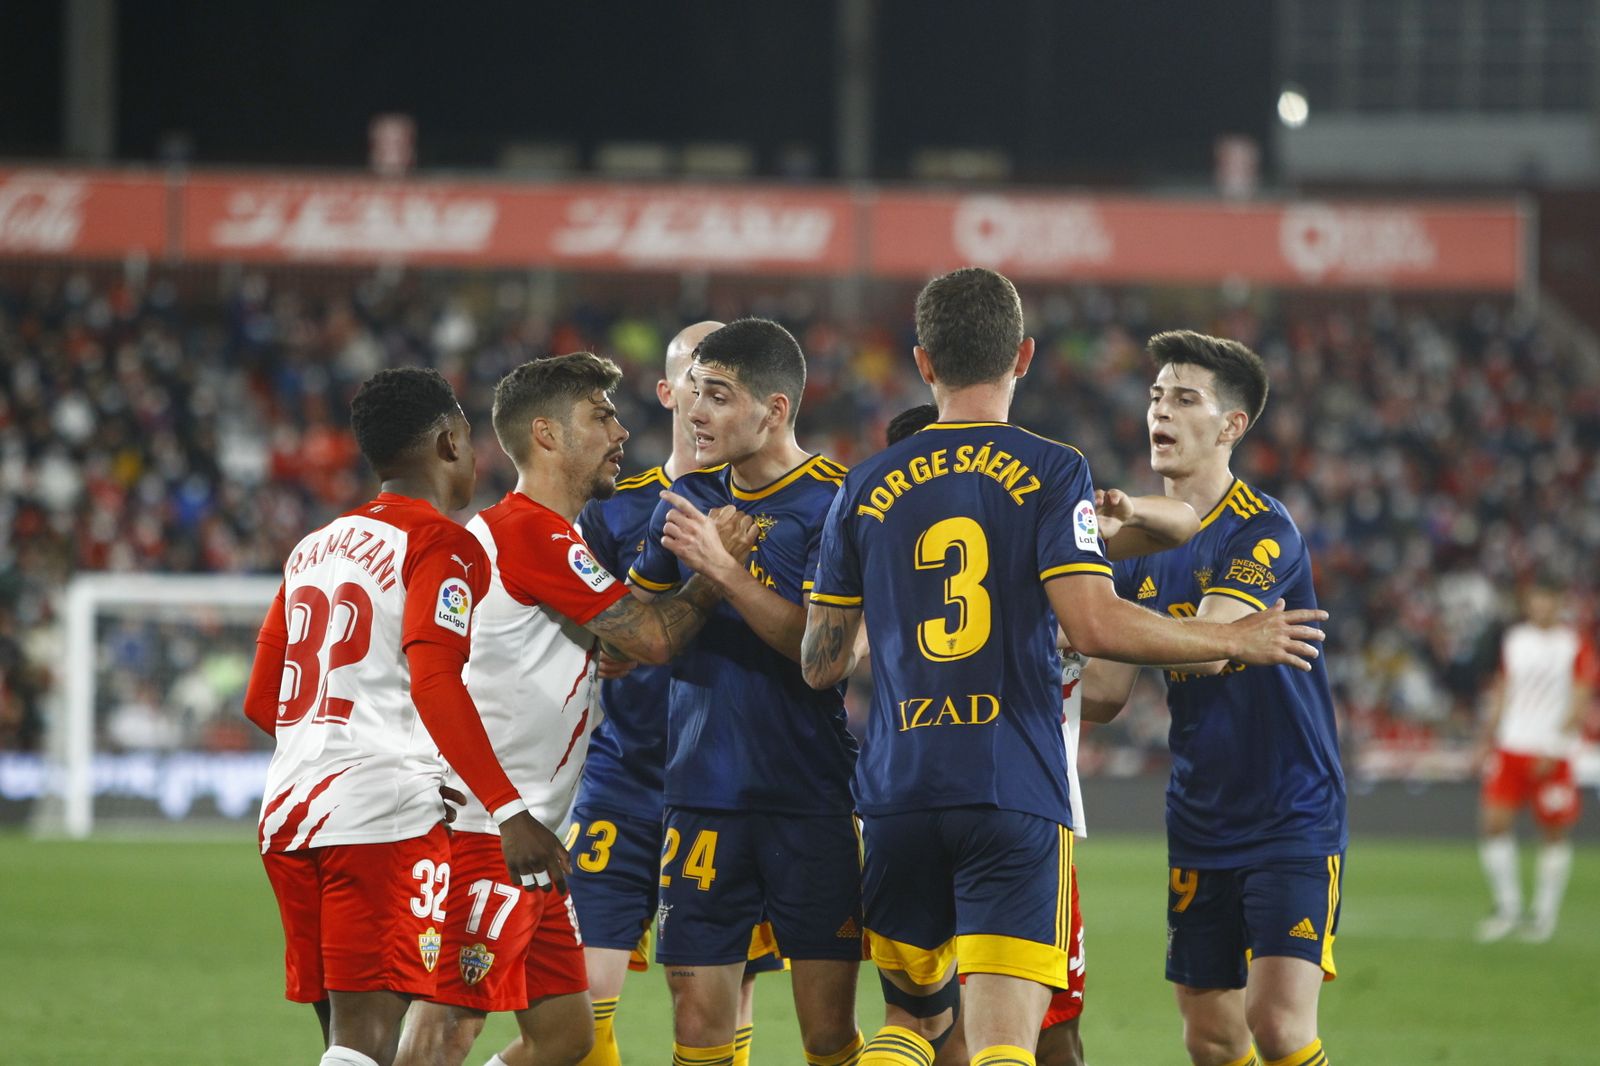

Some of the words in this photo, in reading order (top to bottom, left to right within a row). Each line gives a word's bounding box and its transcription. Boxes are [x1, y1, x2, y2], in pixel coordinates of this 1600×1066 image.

[857, 448, 949, 523] JORGE
[953, 441, 1042, 506] SÁENZ
[289, 526, 397, 594] RAMAZANI
[914, 516, 992, 663] 3
[437, 609, 467, 631] LaLiga
[275, 581, 374, 728] 32
[897, 693, 1001, 732] IZAD
[410, 858, 451, 923] 32
[658, 826, 718, 892] 24
[464, 878, 521, 941] 17
[1288, 930, 1319, 942] adidas
